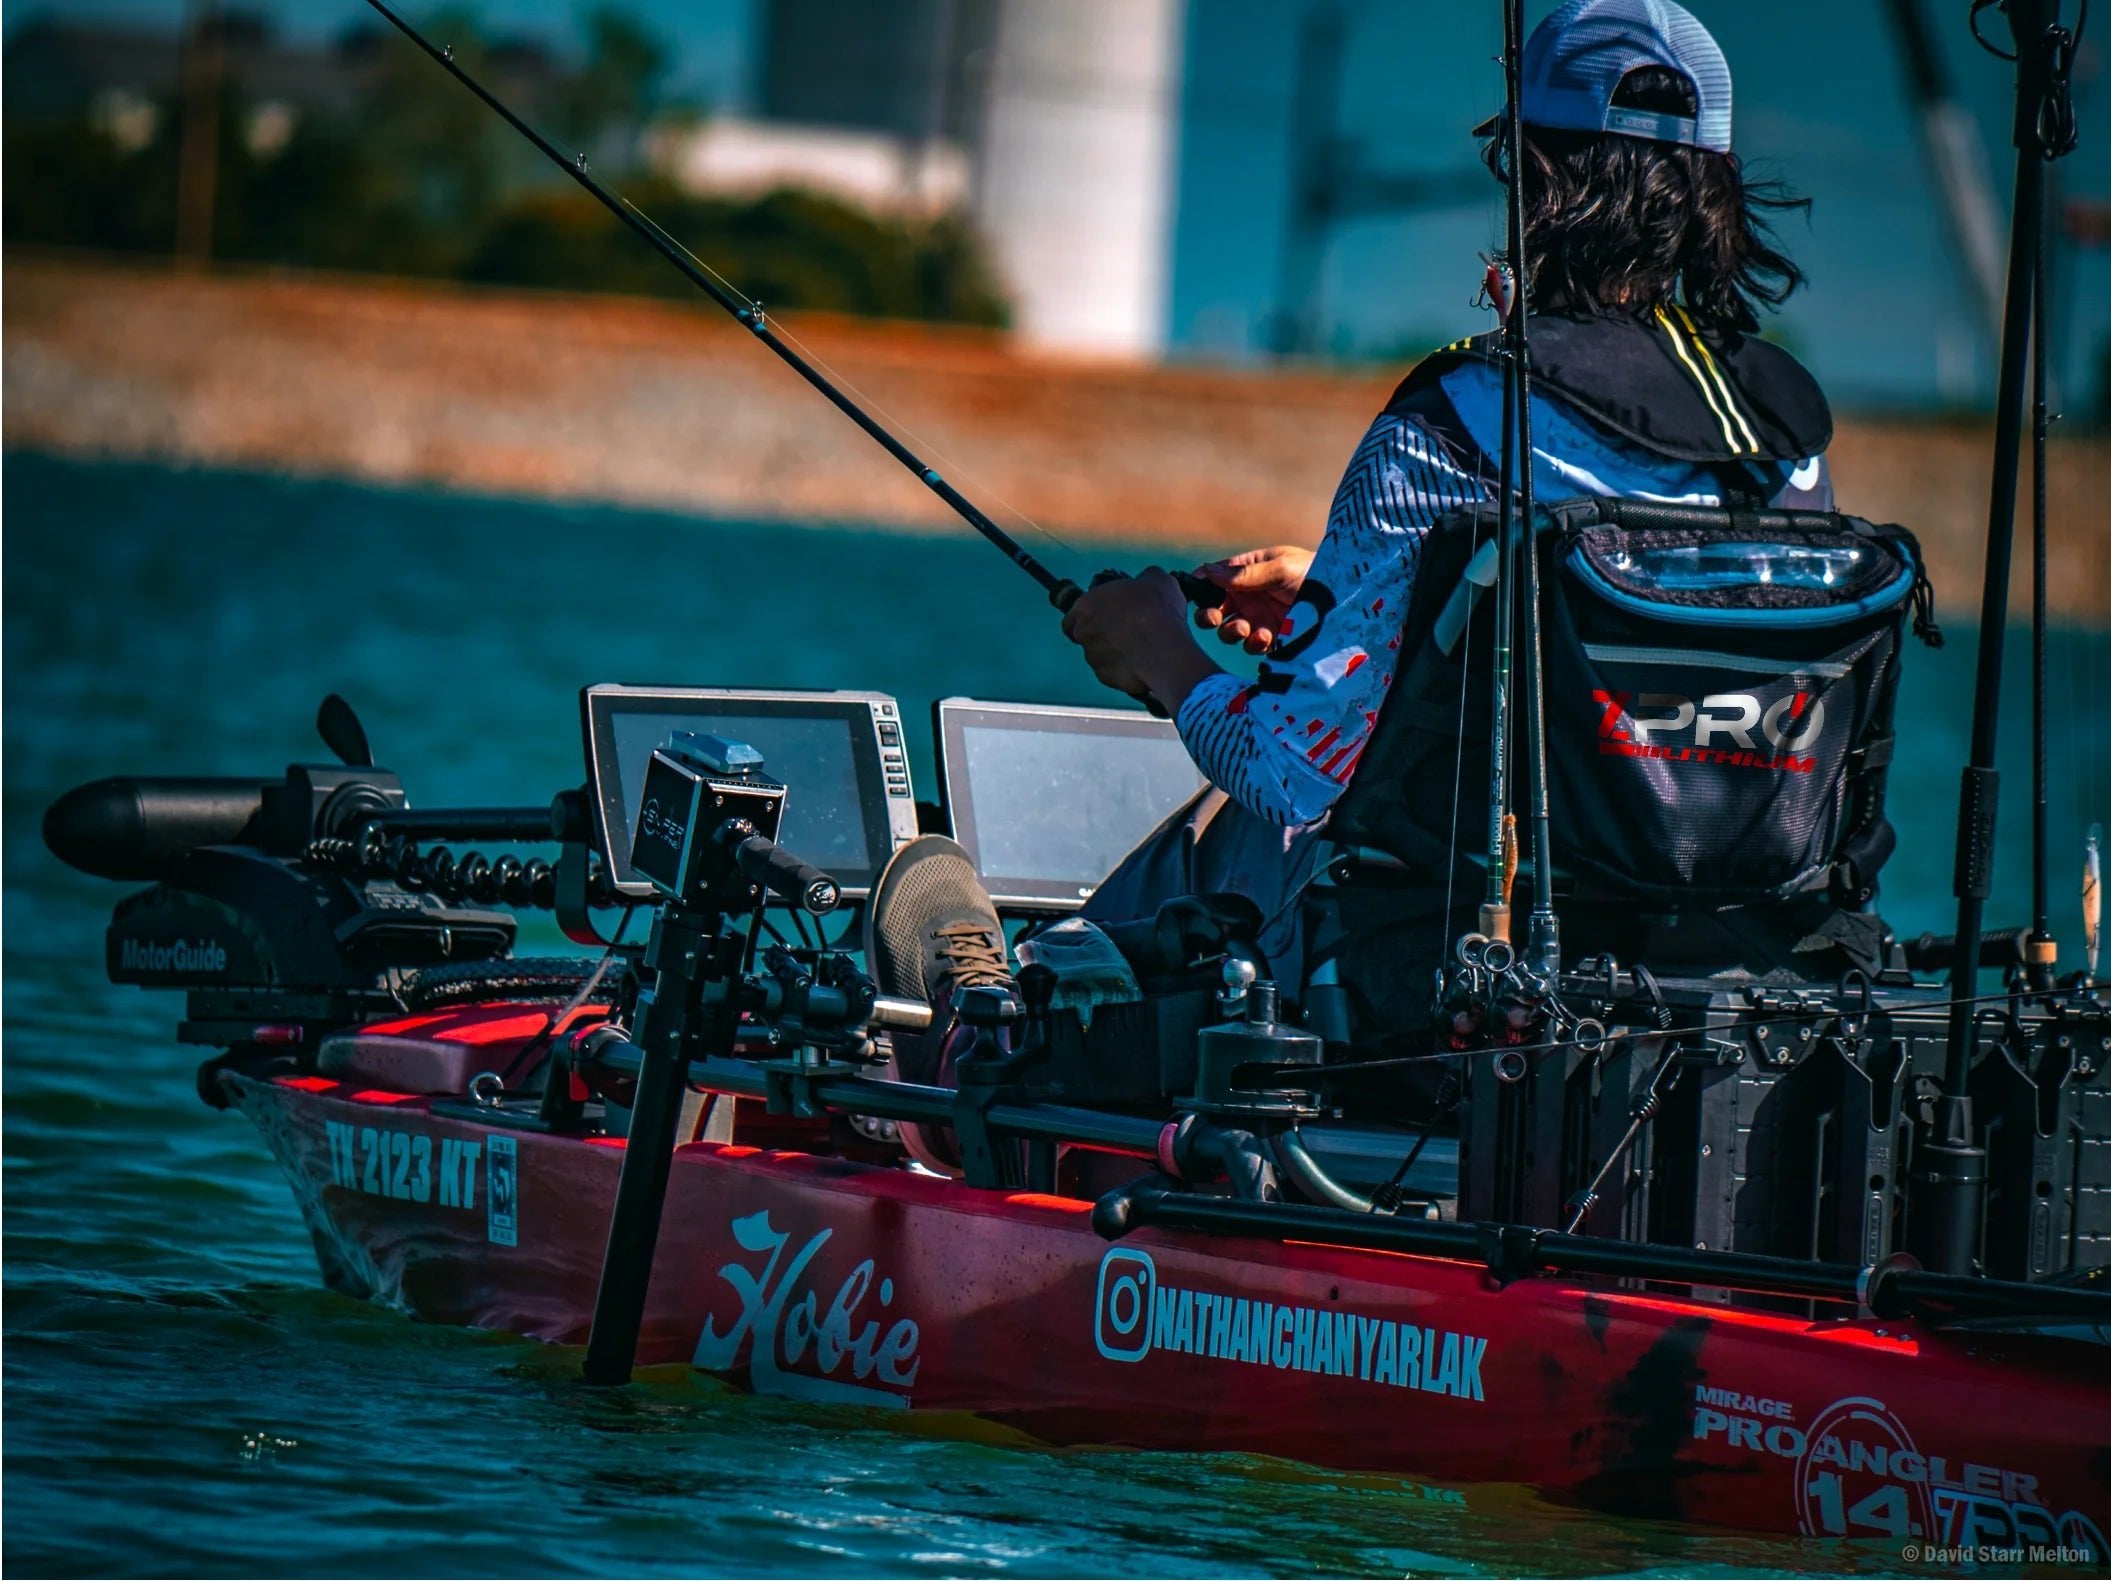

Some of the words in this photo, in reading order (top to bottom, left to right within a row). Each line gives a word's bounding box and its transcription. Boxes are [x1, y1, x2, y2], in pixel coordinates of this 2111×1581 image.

[122, 938, 226, 972] MotorGuide
[325, 1119, 357, 1191] TX
[360, 1127, 432, 1203] 2123
[439, 1137, 482, 1209] KT
[691, 1209, 921, 1409] Hobie
[1153, 1286, 1489, 1402] NATHANCHANYARLAK
[1695, 1384, 1794, 1421] MIRAGE
[1693, 1407, 1808, 1459] PRO
[1809, 1434, 2044, 1505] ANGLER
